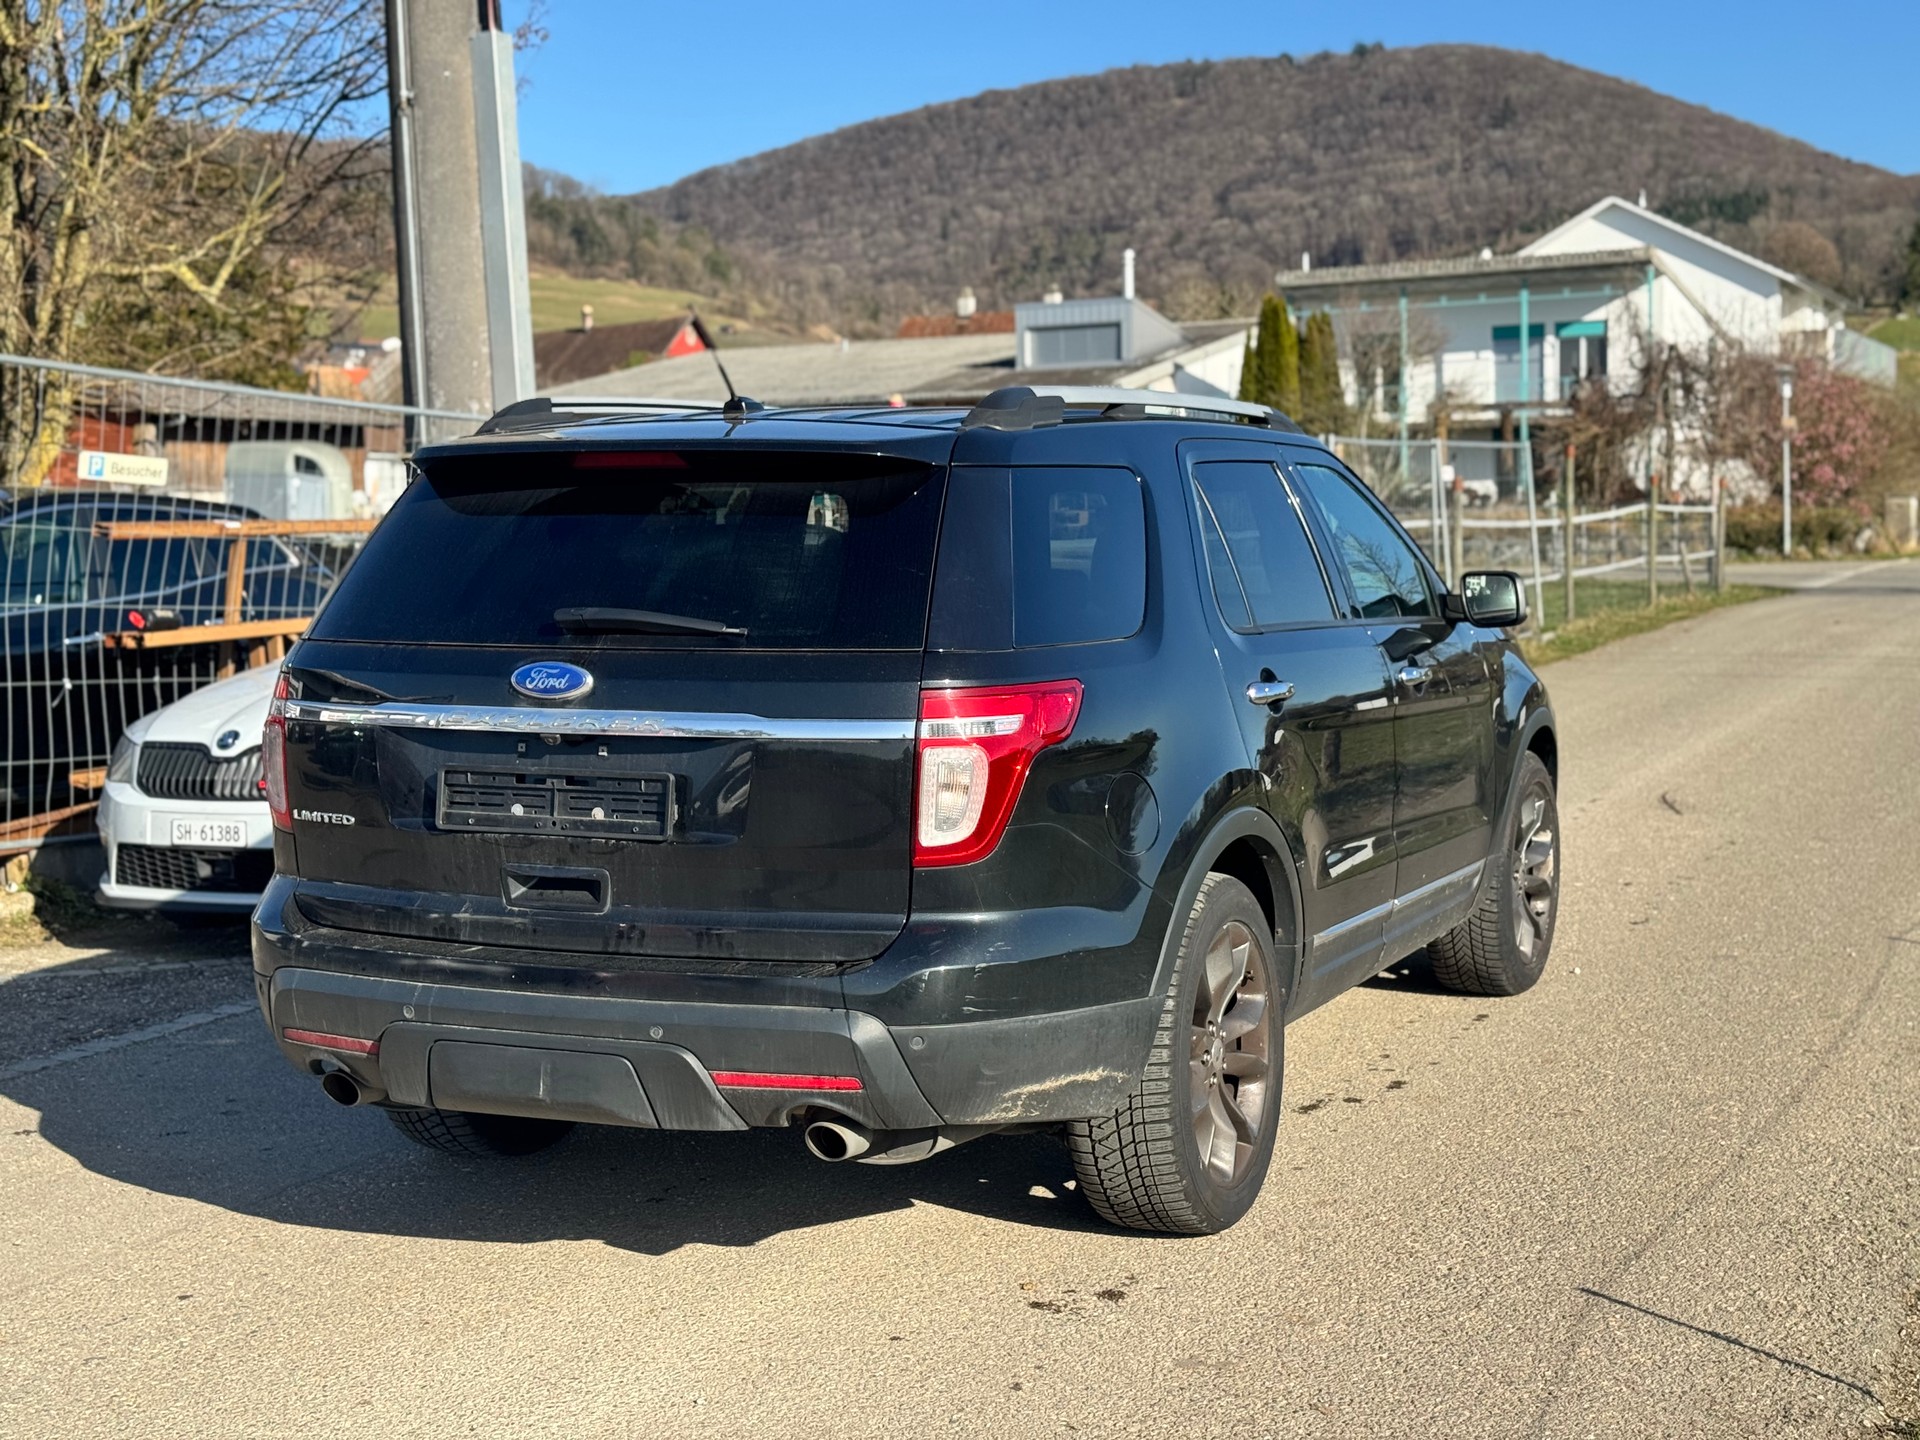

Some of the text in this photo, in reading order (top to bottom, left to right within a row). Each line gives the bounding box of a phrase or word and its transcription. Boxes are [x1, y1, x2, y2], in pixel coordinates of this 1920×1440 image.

[90, 456, 162, 478] P Besucher
[525, 667, 570, 689] Ford
[292, 808, 356, 826] LIMITED
